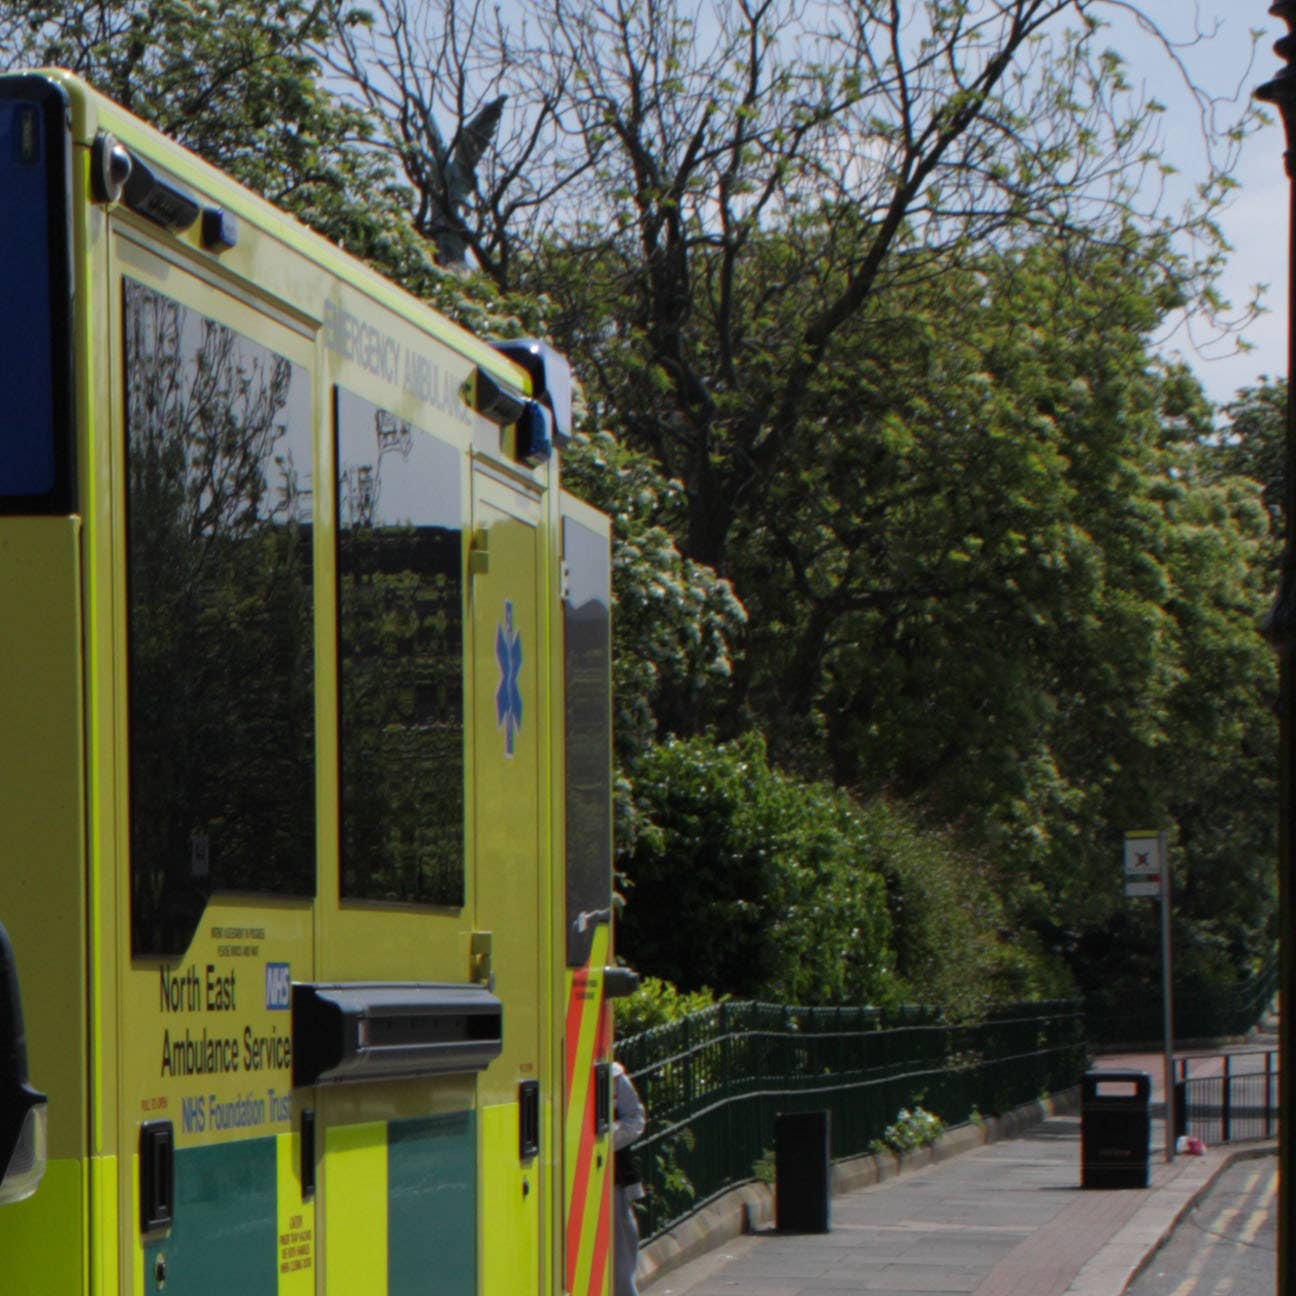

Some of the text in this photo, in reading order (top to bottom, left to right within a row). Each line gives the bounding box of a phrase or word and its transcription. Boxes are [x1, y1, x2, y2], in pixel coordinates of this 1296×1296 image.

[403, 347, 473, 426] AMBULAN
[160, 964, 237, 1013] North East
[266, 964, 290, 1006] NHS
[160, 1025, 291, 1077] Ambulance Service
[182, 1094, 206, 1134] NHS
[209, 1090, 265, 1131] Foundation
